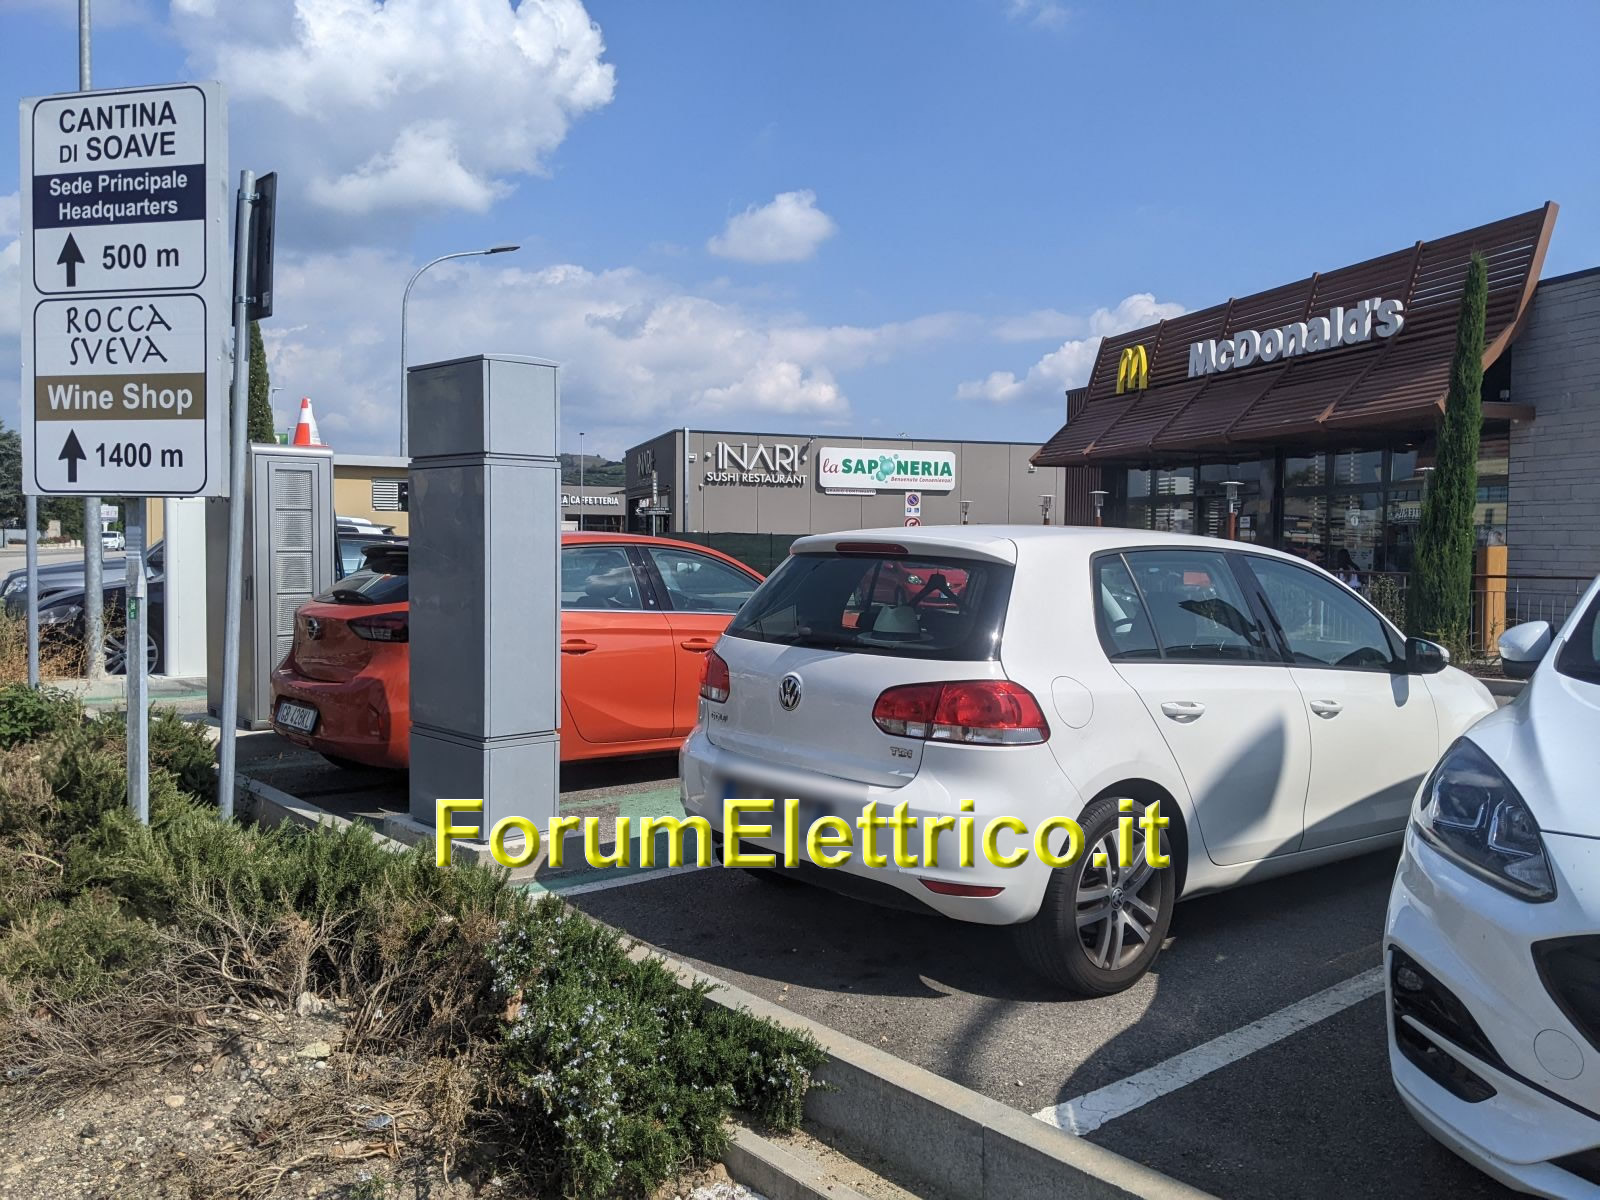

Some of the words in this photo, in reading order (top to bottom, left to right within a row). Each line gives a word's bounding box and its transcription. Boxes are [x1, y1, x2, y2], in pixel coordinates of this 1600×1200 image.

[59, 101, 177, 133] CANTINA
[59, 144, 78, 163] DI
[86, 131, 176, 161] SOAVE
[50, 177, 92, 196] Sede
[98, 170, 188, 194] Principale
[59, 200, 178, 221] Headquarters
[102, 243, 147, 270] 500
[156, 247, 180, 267] m
[66, 304, 172, 333] ROCCA
[69, 335, 168, 365] SVEVA
[1188, 297, 1404, 378] McDonald's
[47, 384, 114, 410] Wine
[122, 383, 193, 415] Shop
[95, 442, 152, 468] 1400
[161, 447, 184, 468] m
[716, 441, 799, 471] INARI
[822, 458, 840, 474] la
[706, 471, 740, 482] SUSHI
[742, 473, 808, 485] RESTAURANT
